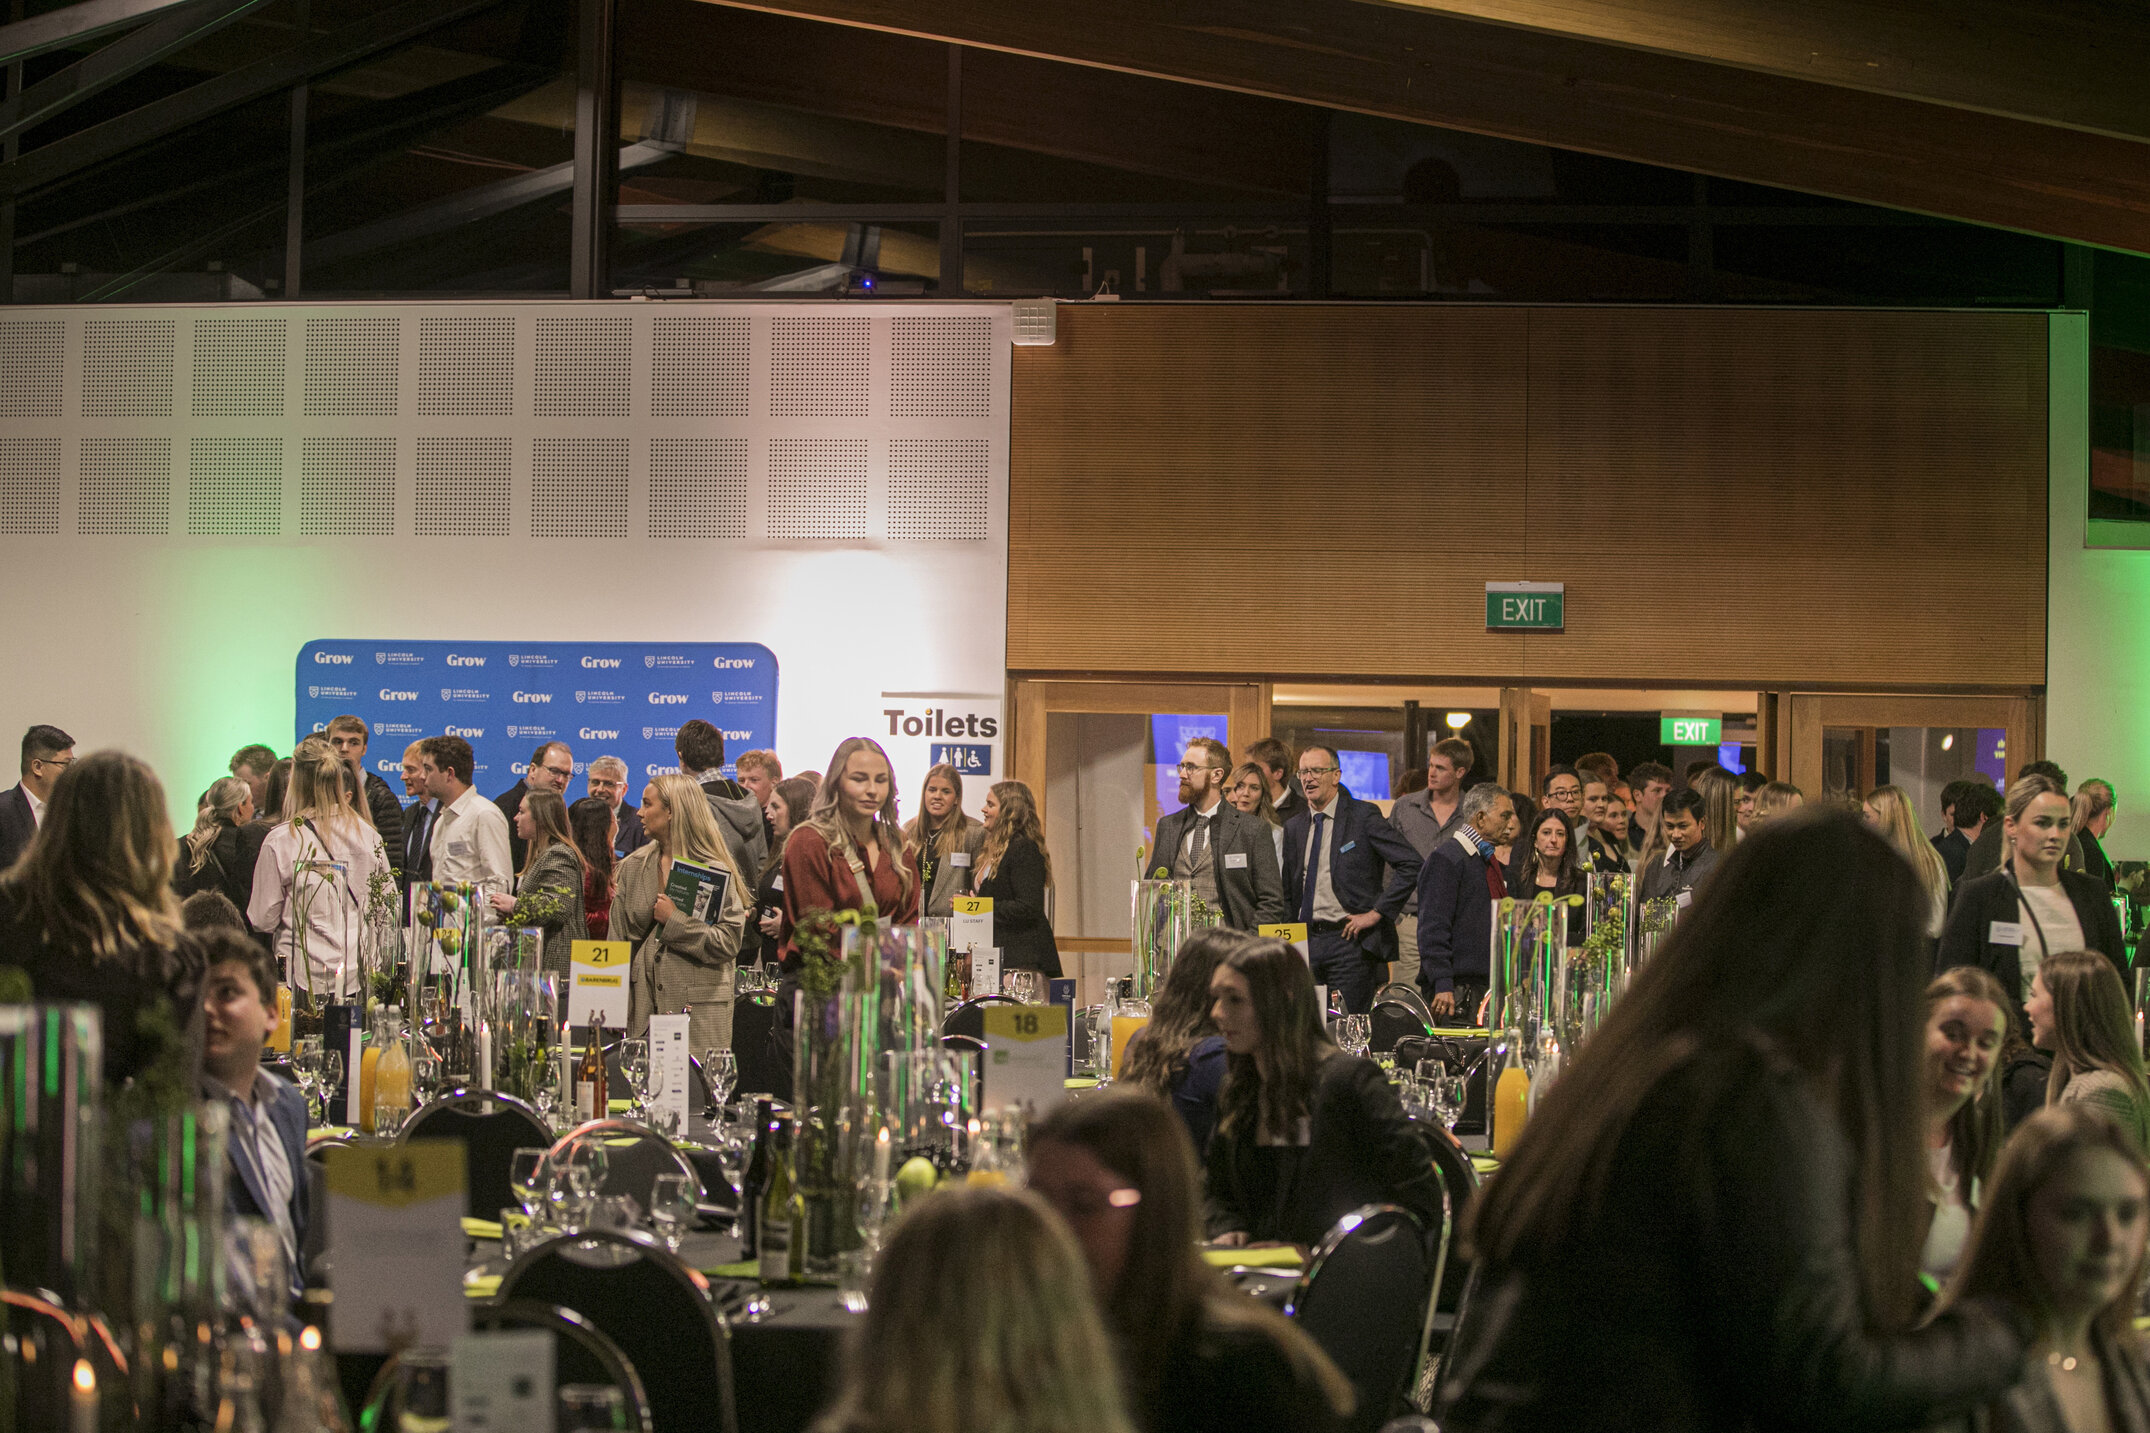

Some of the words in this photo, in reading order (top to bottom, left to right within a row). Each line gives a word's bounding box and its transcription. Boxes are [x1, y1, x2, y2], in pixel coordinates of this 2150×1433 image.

[1502, 598, 1547, 621] EXIT
[314, 651, 354, 664] Grow
[446, 654, 487, 667] Grow
[581, 656, 622, 668] Grow
[713, 656, 756, 669] Grow
[379, 688, 419, 701] Grow
[512, 690, 552, 703] Grow
[648, 692, 689, 704] Grow
[883, 708, 998, 738] Toilets
[444, 725, 485, 738] Grow
[579, 728, 620, 740] Grow
[1673, 722, 1710, 741] EXIT
[377, 760, 404, 772] Gro
[677, 866, 711, 882] Internships
[966, 901, 980, 912] 27
[592, 947, 609, 962] 21
[1014, 1014, 1038, 1035] 18
